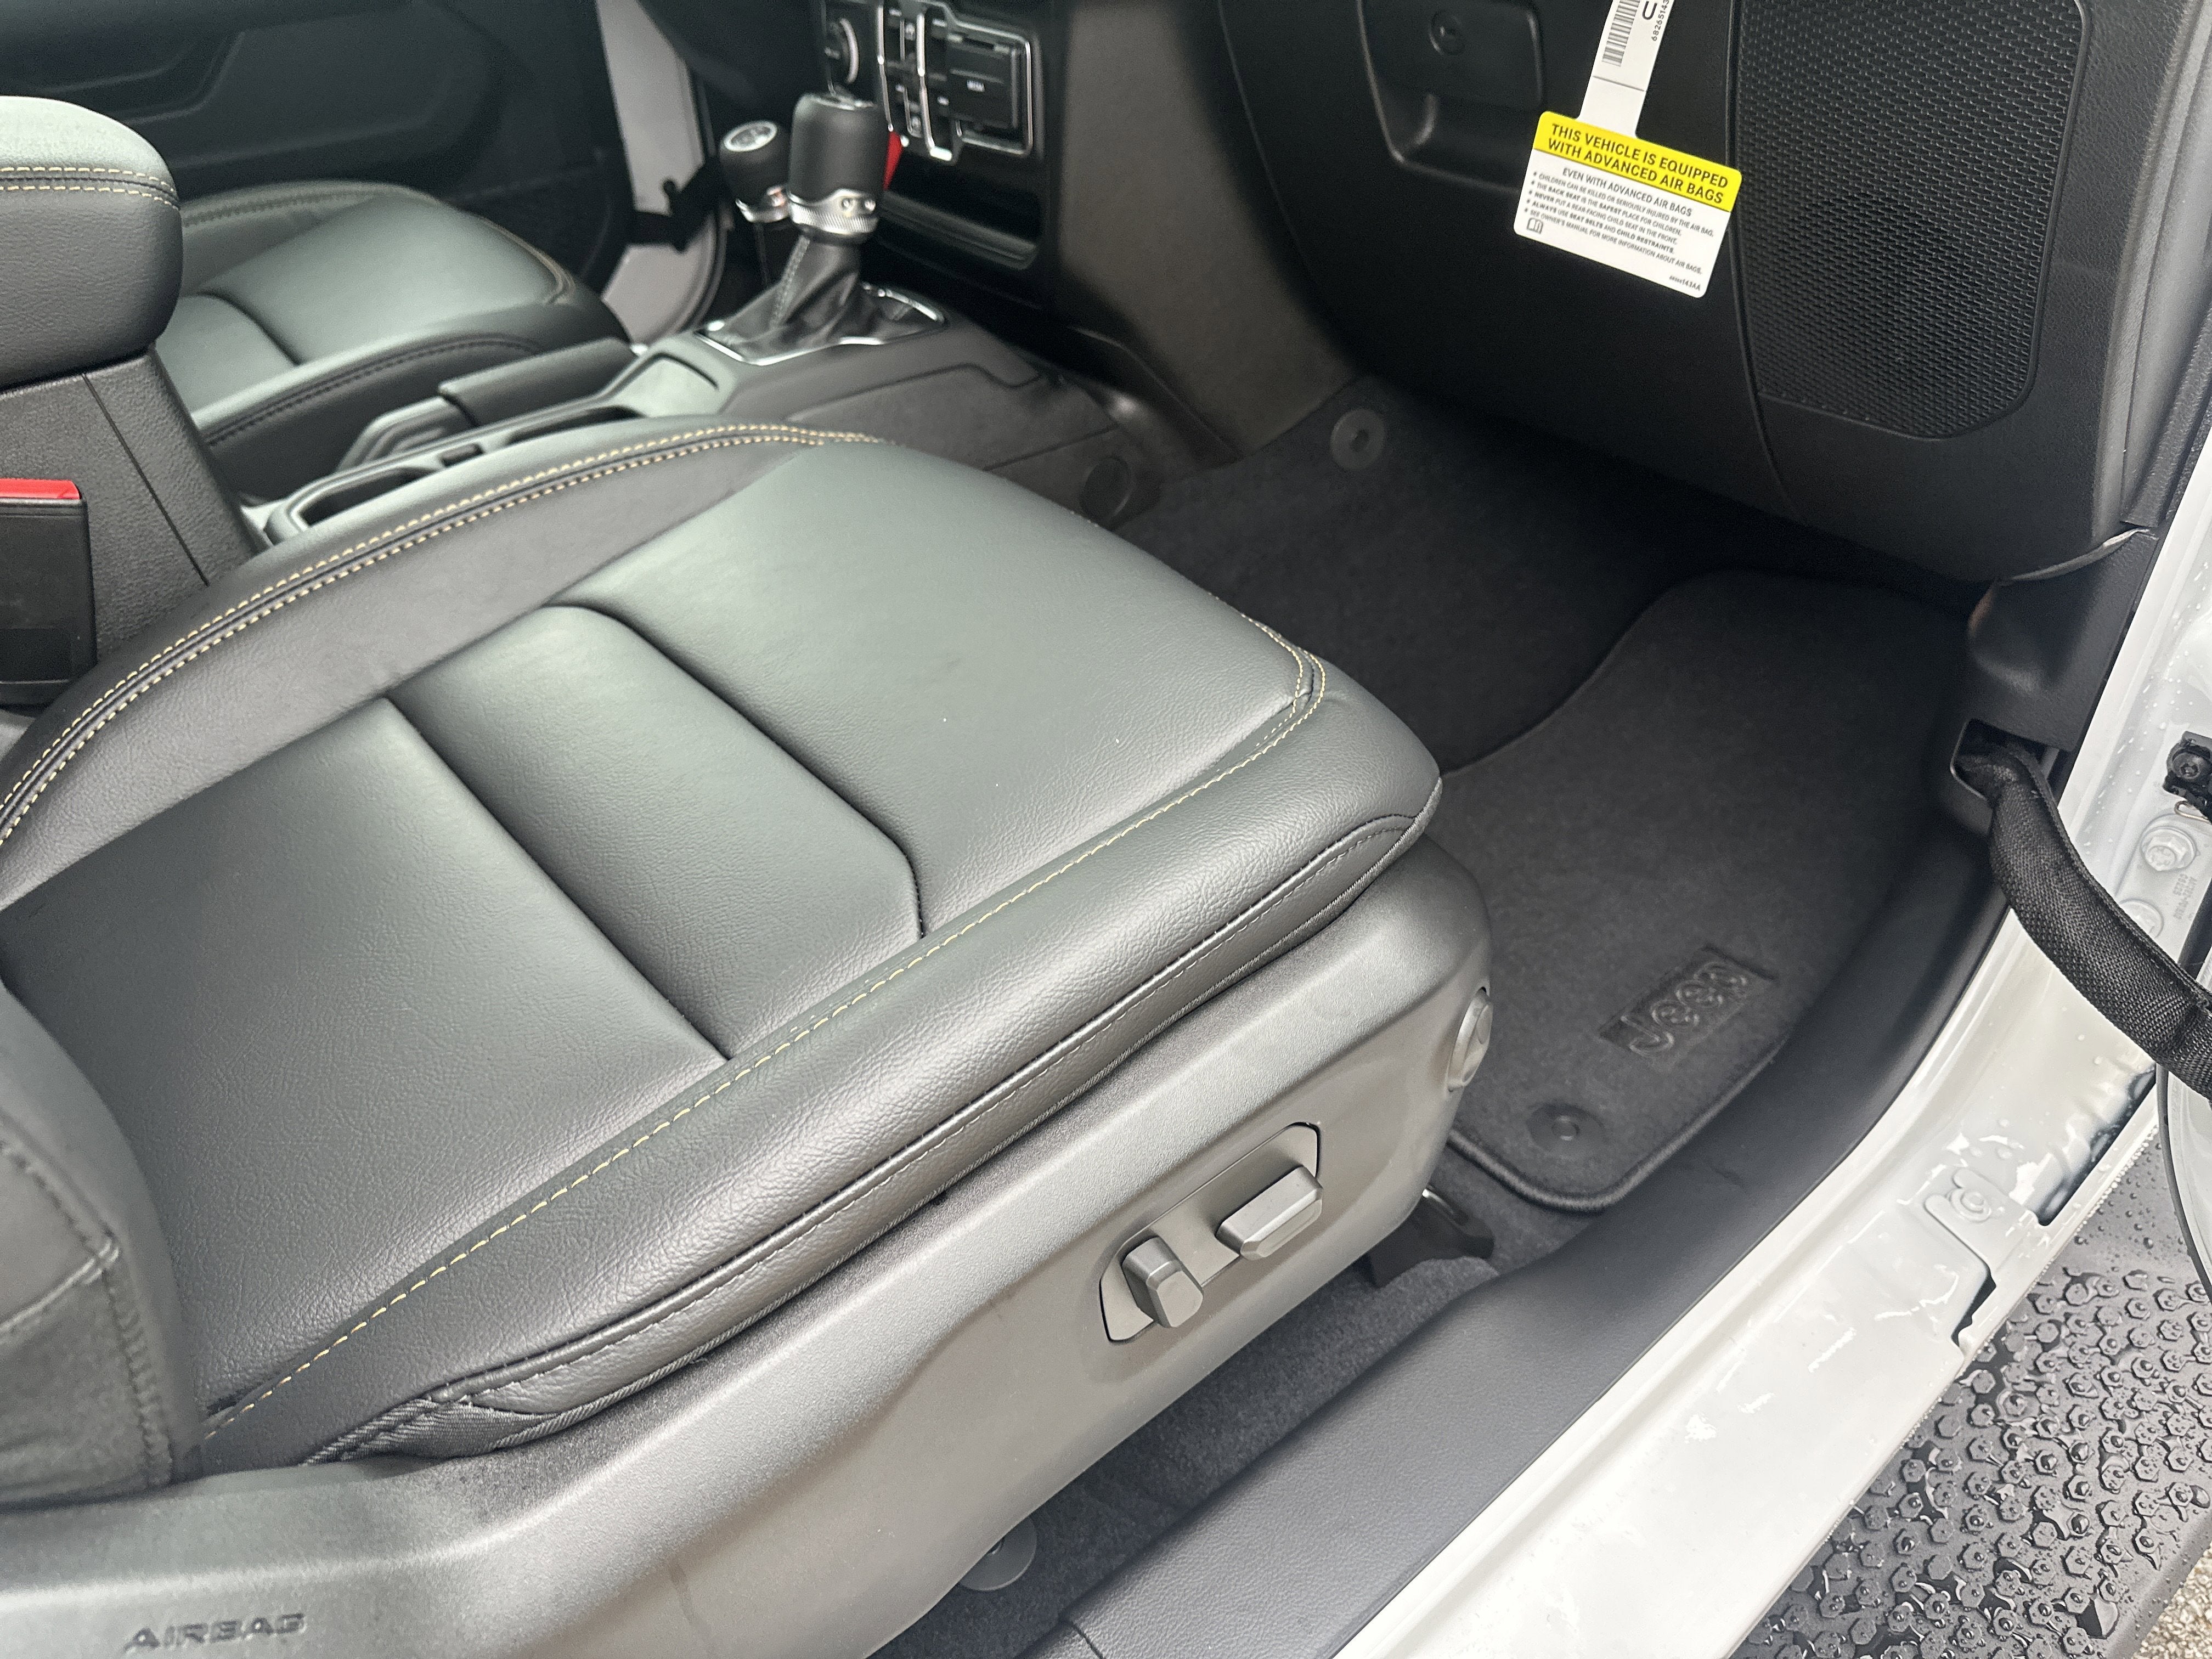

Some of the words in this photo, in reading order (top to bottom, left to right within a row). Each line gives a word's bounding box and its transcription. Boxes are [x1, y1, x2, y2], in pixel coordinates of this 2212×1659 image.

[1549, 138, 1581, 157] WITH
[1584, 151, 1657, 180] ADVANCED
[1660, 174, 1683, 190] AIR
[1686, 182, 1723, 203] BAGS
[1552, 123, 1581, 142] THIS
[1585, 133, 1640, 160] VEHICLE
[1643, 151, 1656, 165] IS
[1659, 157, 1727, 187] EQUIPPED
[1562, 167, 1584, 180] EVEN
[1585, 174, 1606, 188] WITH
[1607, 182, 1652, 202] ADVANCED
[1653, 197, 1668, 208] AIR
[1669, 202, 1691, 216] BAGS
[1620, 962, 1749, 1058] Jeep
[124, 1612, 307, 1651] AIRBAG
